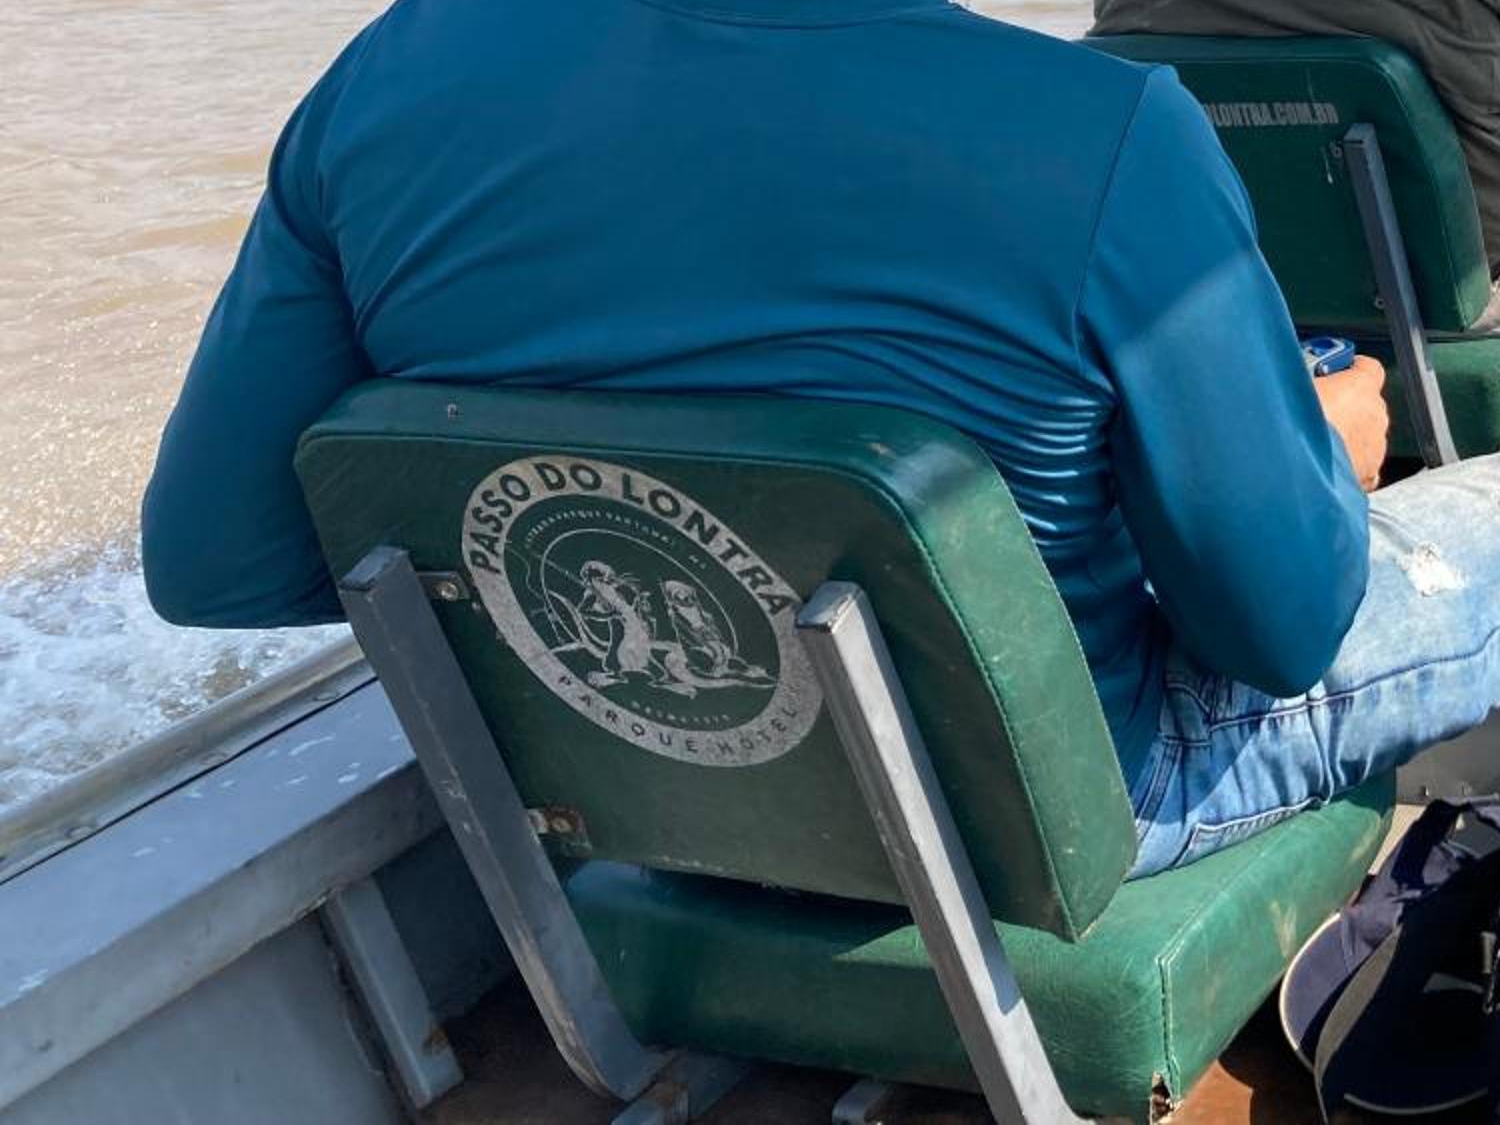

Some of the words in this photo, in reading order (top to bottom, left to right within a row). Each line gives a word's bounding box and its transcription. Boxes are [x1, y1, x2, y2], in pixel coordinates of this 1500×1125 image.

[470, 473, 531, 575] PASSO
[534, 462, 601, 491] DO
[620, 471, 795, 617] LONTRA
[558, 674, 699, 755] PARQUE
[716, 705, 798, 756] HOTEL
